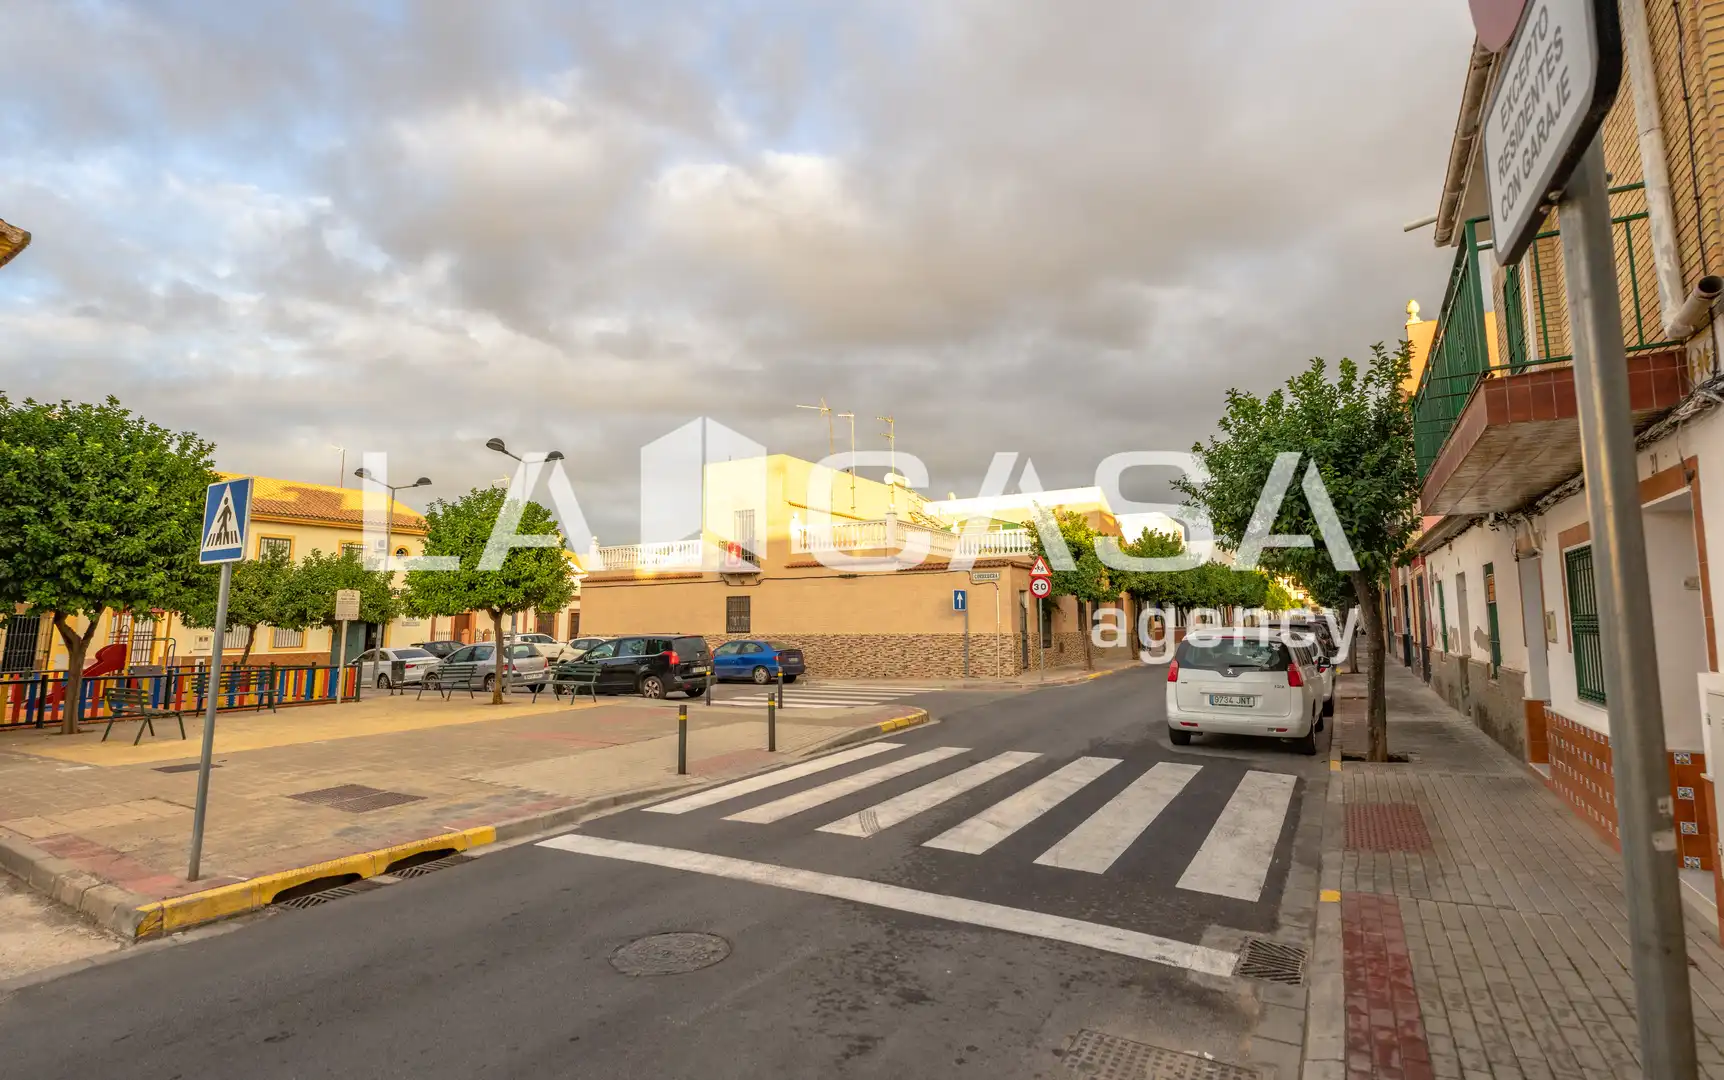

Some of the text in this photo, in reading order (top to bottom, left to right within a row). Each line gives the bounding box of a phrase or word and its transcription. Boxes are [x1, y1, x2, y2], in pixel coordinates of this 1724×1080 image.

[1498, 25, 1564, 185] RESIDENTES
[1500, 5, 1549, 133] EXCEPTO
[1501, 65, 1571, 222] CON GARAJE
[1034, 583, 1047, 591] 30
[1215, 695, 1250, 704] 9734 JNT
